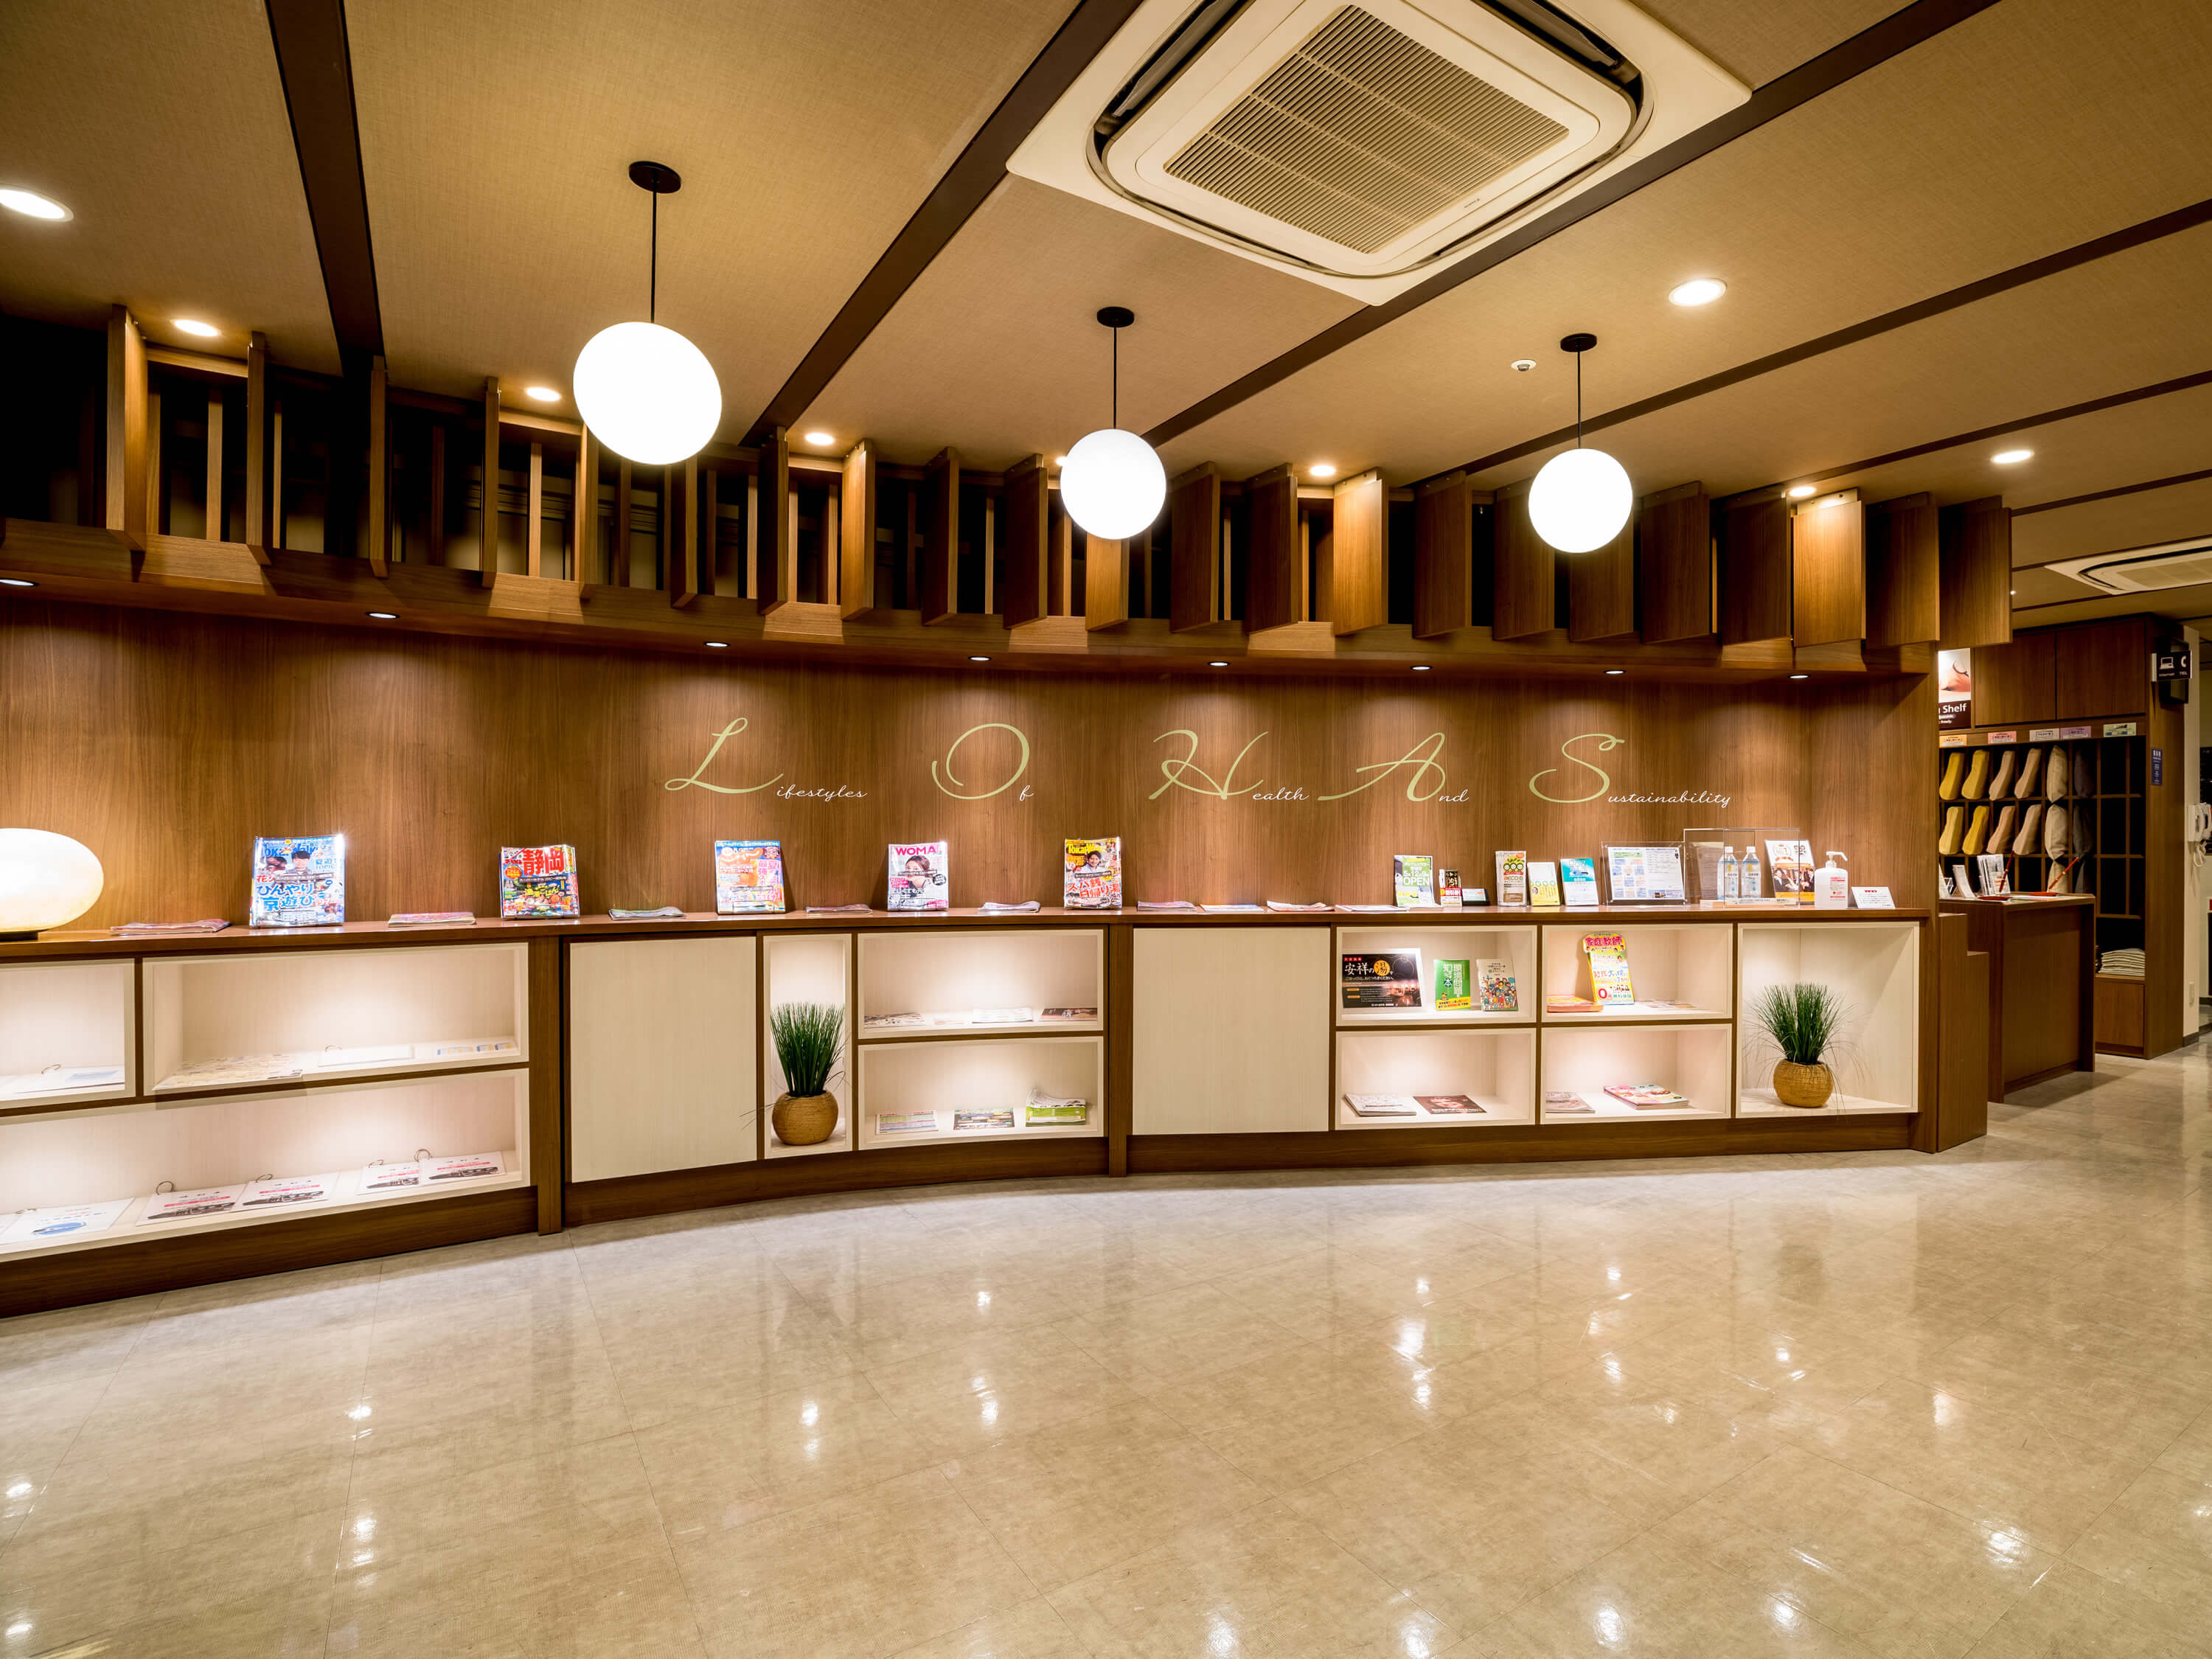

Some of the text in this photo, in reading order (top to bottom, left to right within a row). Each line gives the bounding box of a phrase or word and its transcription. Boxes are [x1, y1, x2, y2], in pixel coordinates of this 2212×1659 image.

[1942, 703, 1967, 714] Shelf
[664, 717, 1731, 809] Lifestyles Of Health And Sustainability
[523, 848, 565, 876] 静岡
[1403, 877, 1430, 886] OPEN
[257, 884, 313, 896] ひんやり
[1585, 935, 1622, 947] 家庭教師
